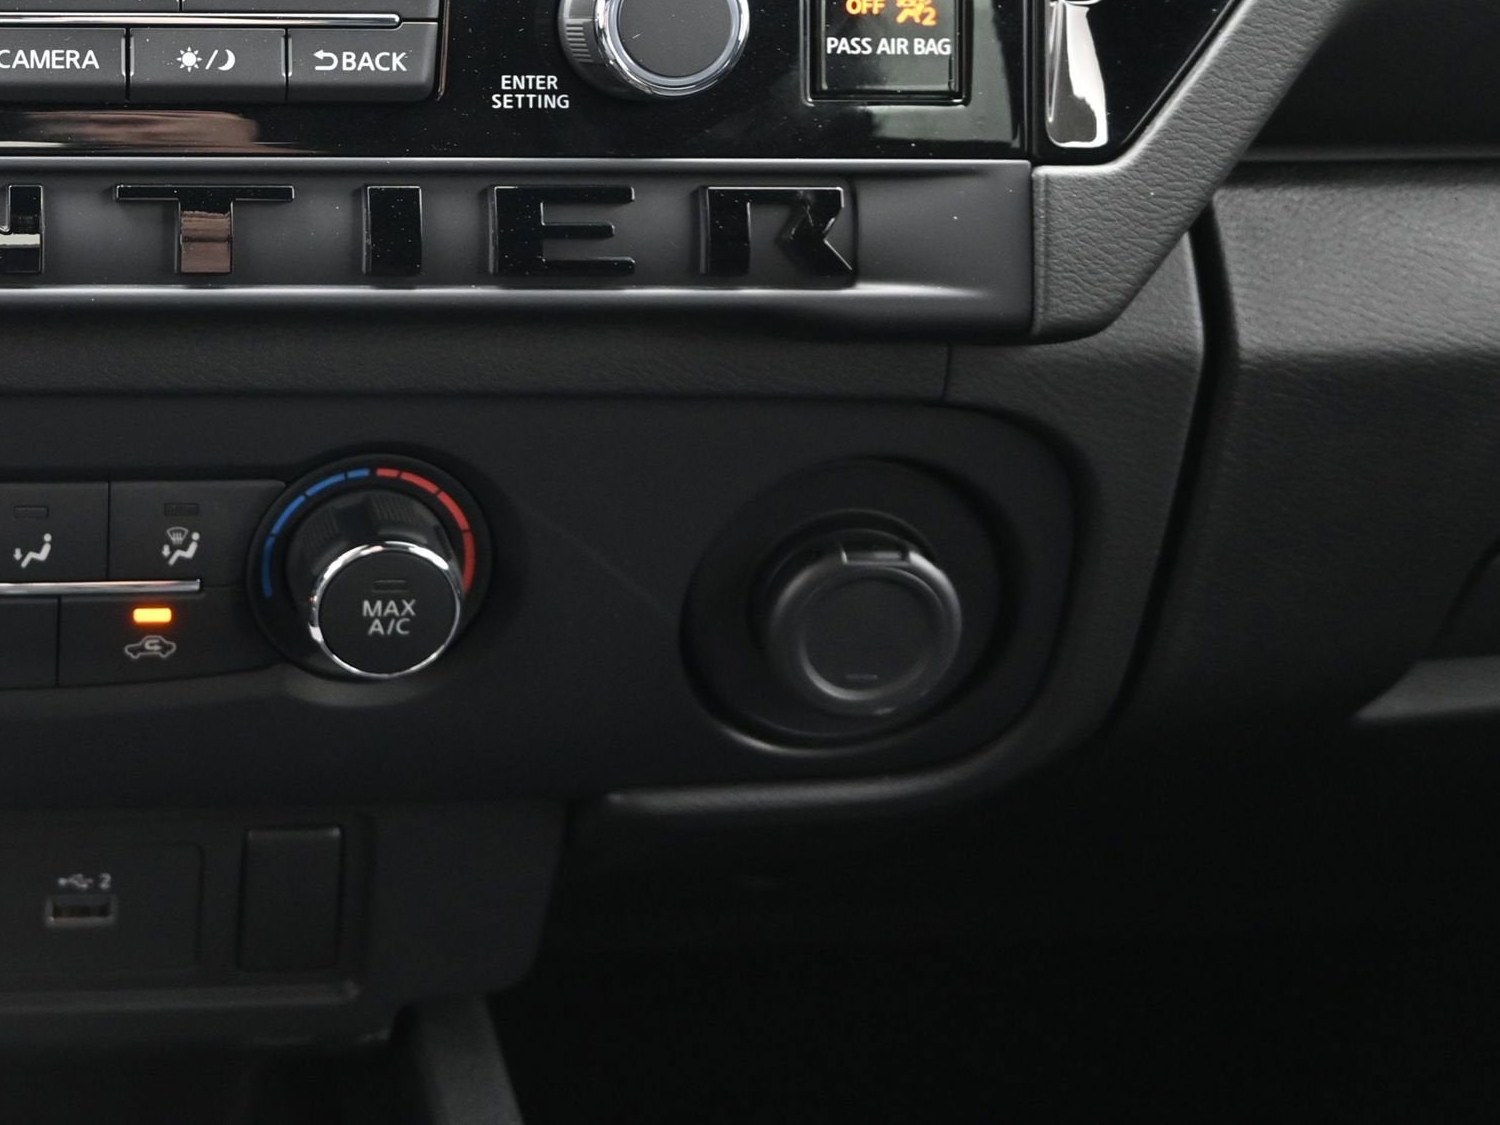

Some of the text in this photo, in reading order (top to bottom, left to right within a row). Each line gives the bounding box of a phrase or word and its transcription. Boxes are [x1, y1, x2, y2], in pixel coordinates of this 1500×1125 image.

[826, 37, 951, 55] PASS AIR BAG
[342, 51, 407, 72] BACK
[501, 74, 558, 90] ENTER
[491, 93, 570, 109] SETTING
[362, 599, 416, 618] MAX
[368, 617, 410, 635] A/C
[98, 872, 113, 891] 2
